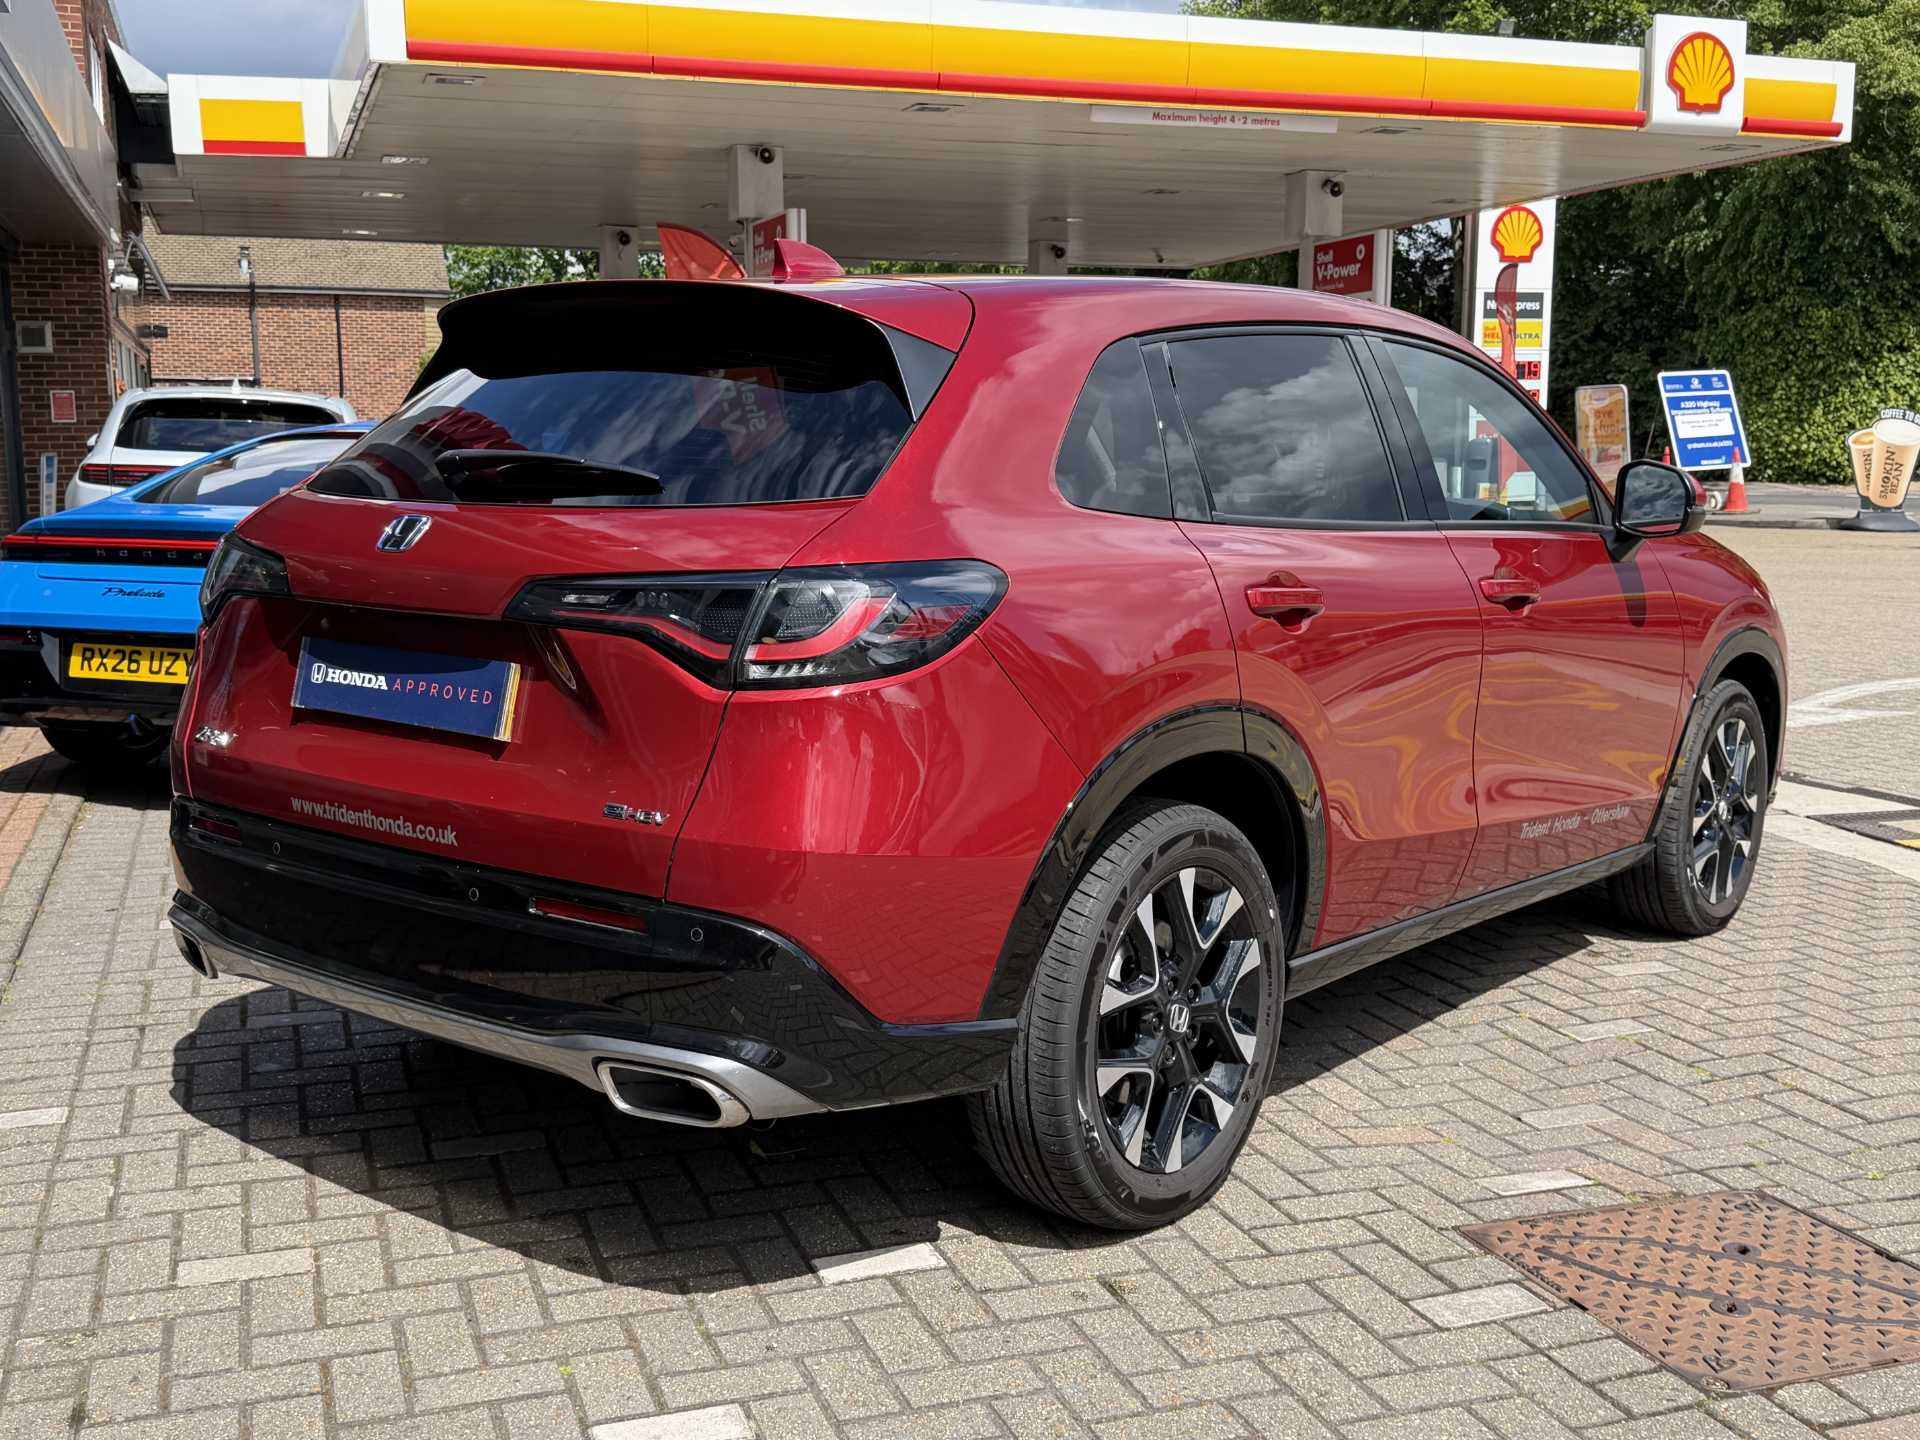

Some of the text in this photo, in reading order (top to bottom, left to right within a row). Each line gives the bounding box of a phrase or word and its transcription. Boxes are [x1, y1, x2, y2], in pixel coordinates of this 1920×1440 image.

[1152, 112, 1197, 122] Maximum
[1199, 113, 1227, 126] height
[1251, 118, 1281, 126] metres
[1317, 263, 1361, 280] V-Power
[1881, 409, 1905, 419] COFFEE
[1905, 410, 1915, 421] TO
[1889, 462, 1904, 494] BEAN
[102, 586, 165, 599] Prelude
[80, 646, 194, 678] RX26 UZY
[326, 667, 493, 705] HONDA APPROVED
[291, 797, 458, 847] www.tridenthonda.co.uk
[1520, 821, 1551, 839] Trident
[1552, 812, 1581, 833] Honda
